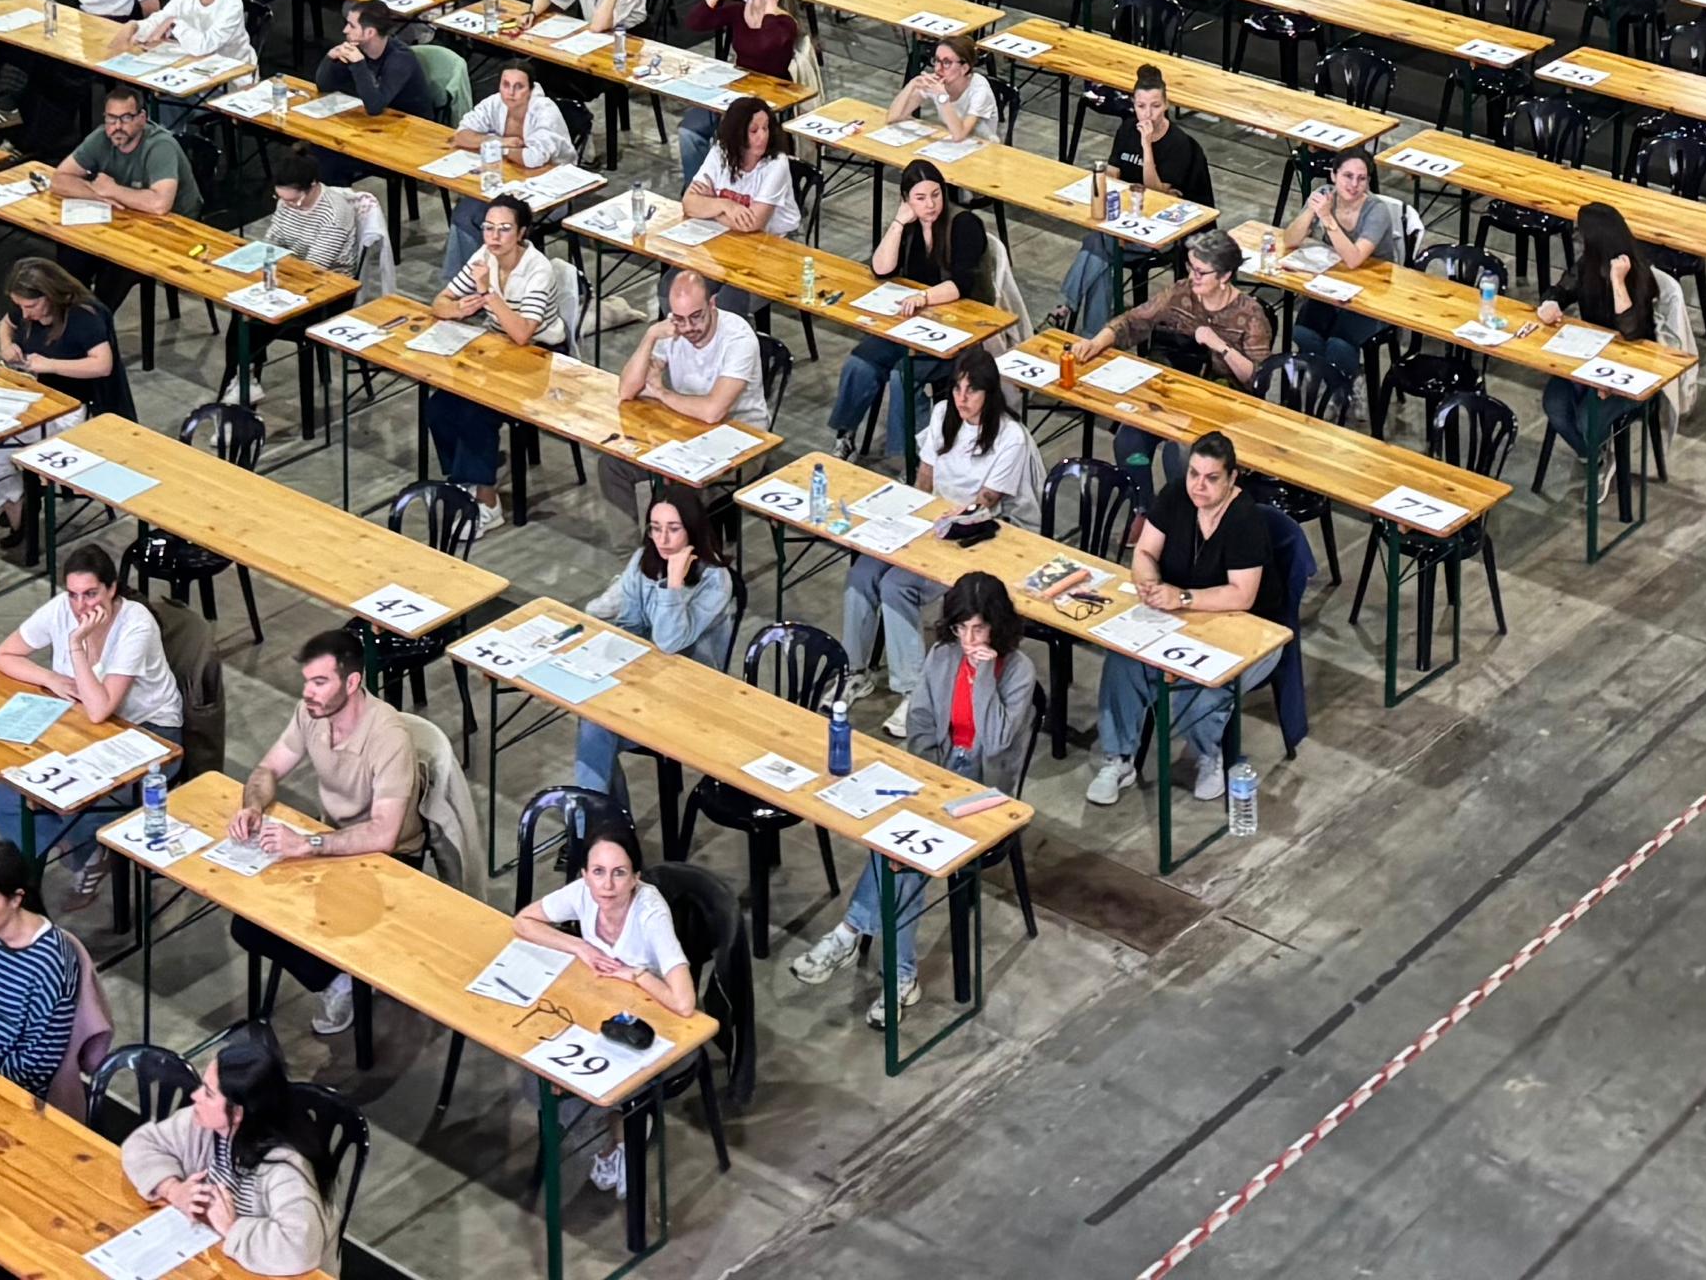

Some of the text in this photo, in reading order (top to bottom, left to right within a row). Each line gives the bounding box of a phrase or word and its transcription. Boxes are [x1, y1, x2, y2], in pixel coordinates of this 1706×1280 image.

[911, 16, 953, 30] 113
[992, 39, 1036, 53] 112
[1549, 66, 1594, 80] 126
[805, 122, 833, 134] 96
[1298, 124, 1345, 142] 111
[1398, 154, 1449, 172] 110
[1116, 220, 1155, 235] 95
[328, 327, 367, 341] 64
[906, 325, 947, 341] 79
[1003, 359, 1045, 377] 78
[1595, 368, 1634, 384] 93
[761, 492, 803, 511] 62
[1396, 498, 1443, 517] 77
[377, 600, 424, 618] 47
[1163, 647, 1210, 668] 61
[26, 768, 79, 793] 31
[890, 830, 943, 854] 45
[548, 1044, 611, 1075] 29
